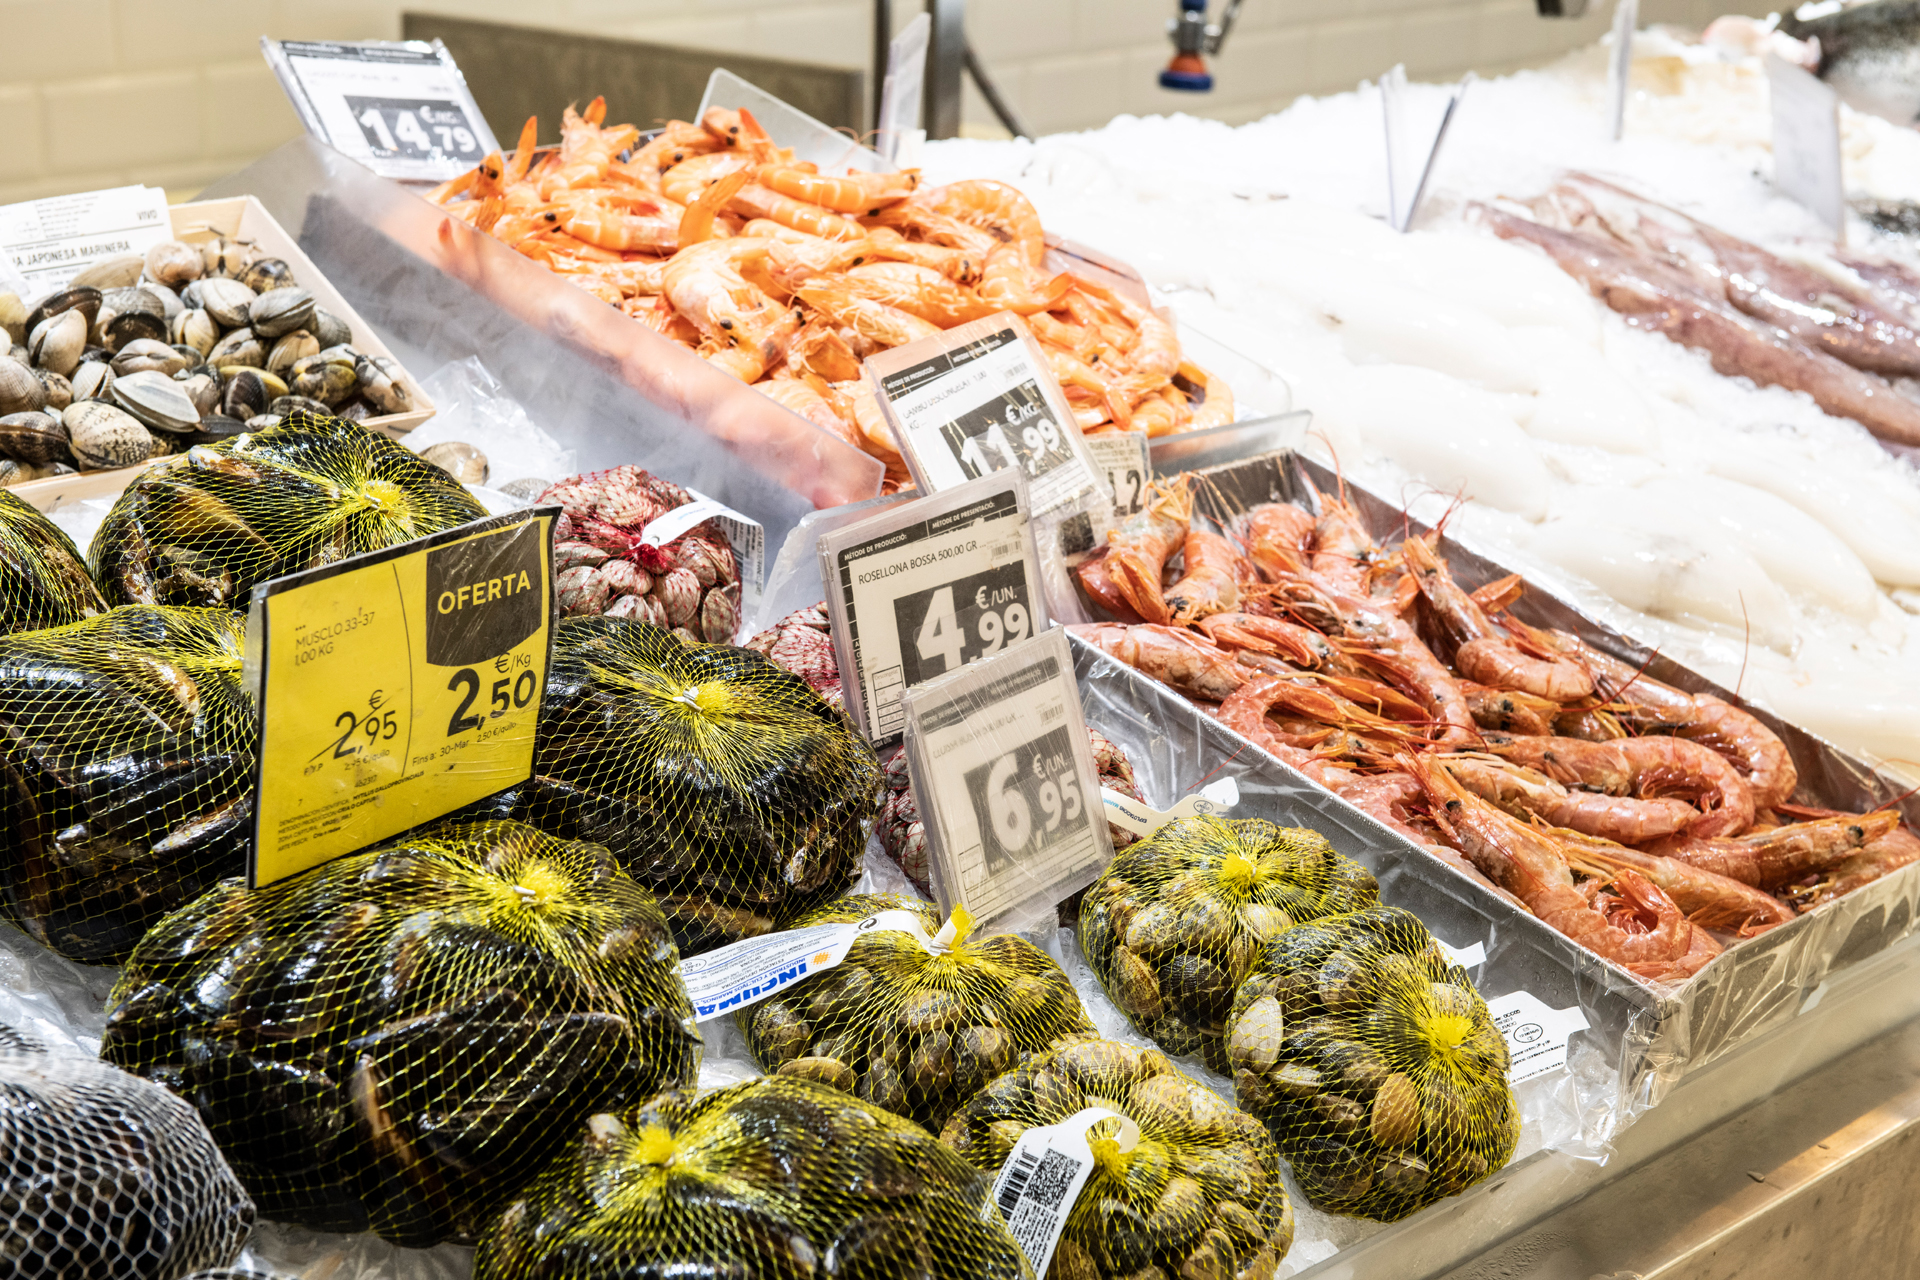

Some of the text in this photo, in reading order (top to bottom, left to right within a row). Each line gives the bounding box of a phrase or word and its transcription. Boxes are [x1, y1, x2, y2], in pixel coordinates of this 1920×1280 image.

[858, 540, 978, 585] ROSELLONA BOSSA 500,00 GR
[867, 545, 873, 553] DE
[437, 569, 531, 615] OFERTA
[296, 611, 375, 650] MUSCLO 33-37
[318, 641, 334, 657] KG
[495, 651, 532, 674] €/Kg
[446, 667, 537, 737] 2,50
[333, 709, 398, 760] 2,95
[412, 756, 428, 766] Fins
[440, 739, 470, 757] 30-Mar
[987, 752, 1082, 852] 6,95
[756, 957, 785, 973] ESTACIÓN
[767, 957, 806, 976] INDUSTRIAS
[692, 962, 807, 1019] INCUMA
[720, 970, 757, 989] DEPURADORA
[1046, 1214, 1059, 1241] ALMEJA
[1028, 1239, 1038, 1260] CAPTU
[1033, 1242, 1049, 1274] JAPONES
